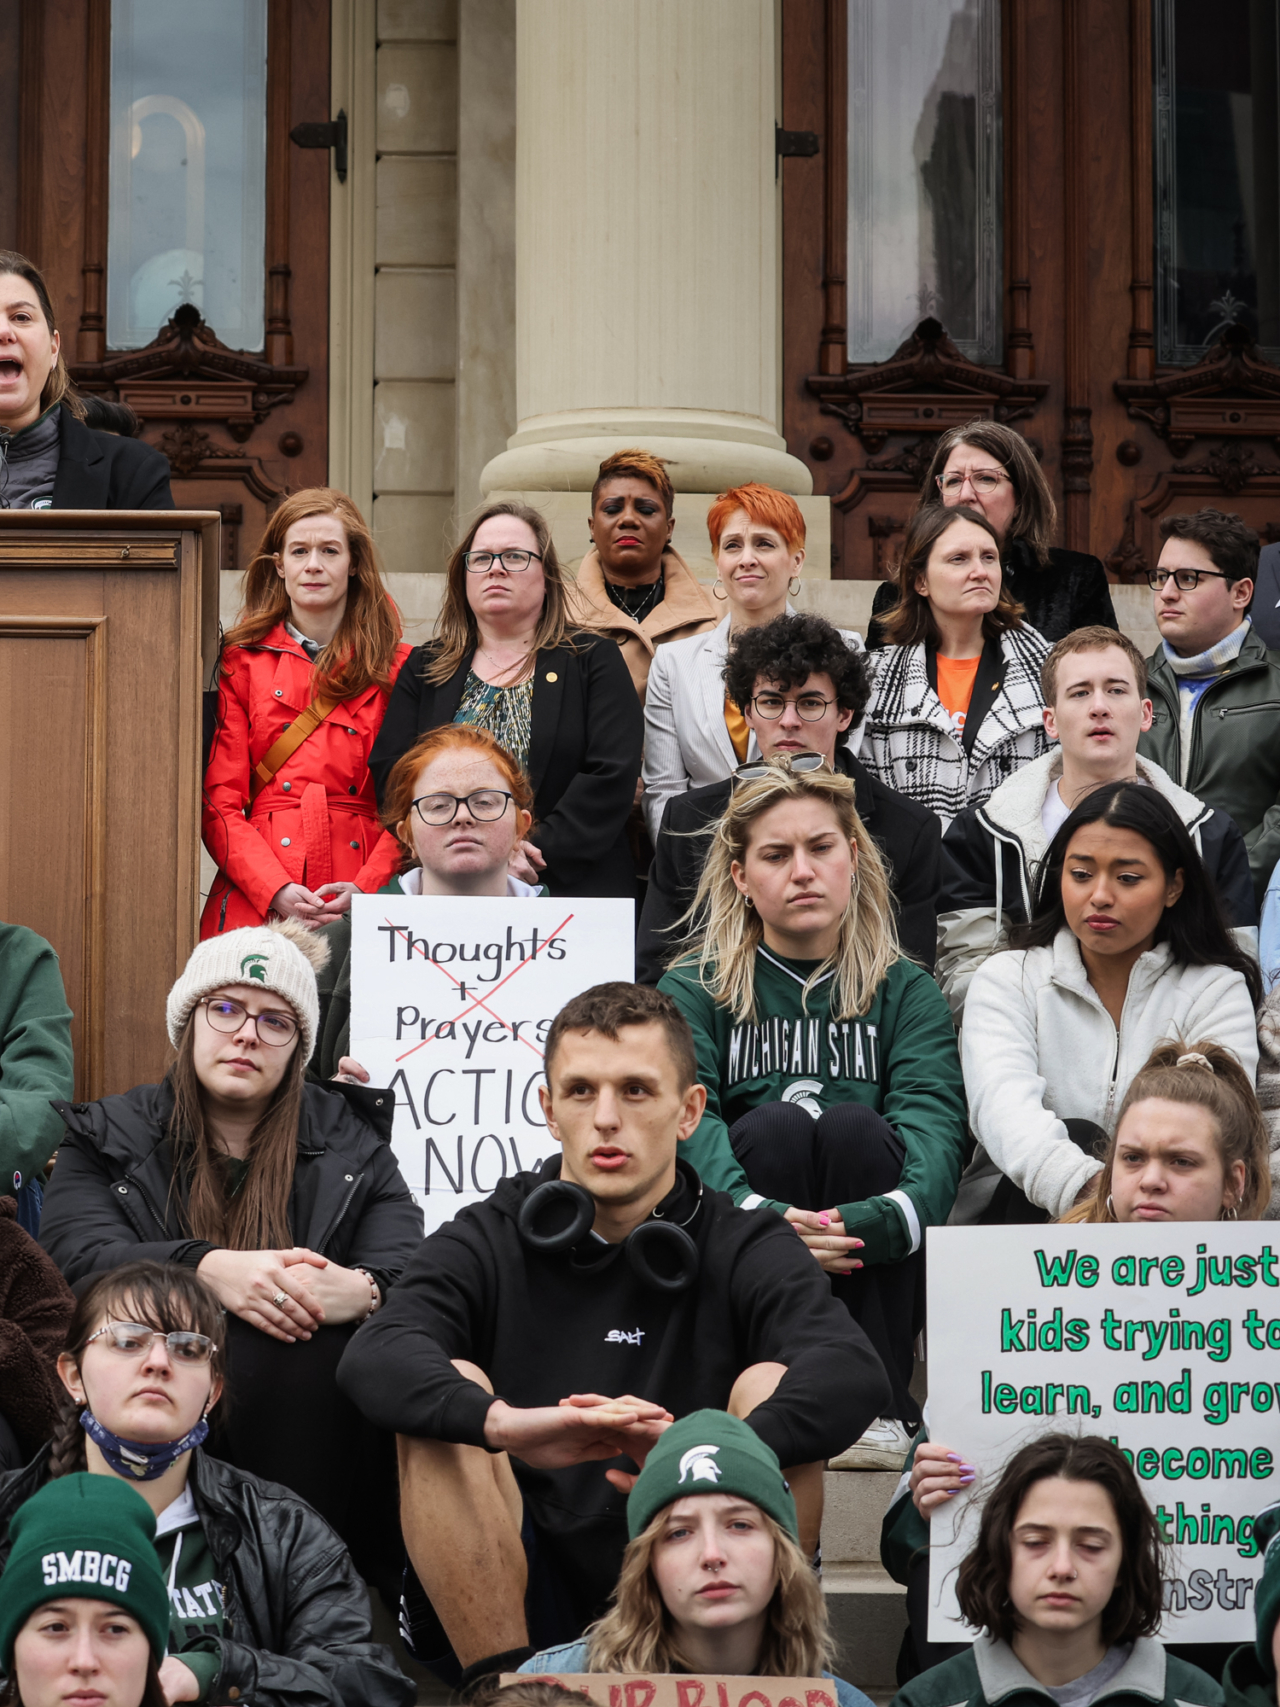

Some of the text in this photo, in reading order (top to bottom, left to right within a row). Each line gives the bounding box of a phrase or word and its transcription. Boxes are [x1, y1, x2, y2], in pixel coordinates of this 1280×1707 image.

[377, 926, 567, 982] Thoughts
[727, 1016, 820, 1086] MICHIGAN
[1034, 1243, 1280, 1296] We are just
[1000, 1307, 1090, 1352] kids
[1101, 1308, 1232, 1362] trying
[981, 1368, 1280, 1425] learn, and gro
[42, 1550, 132, 1592] SMBCG
[1161, 1568, 1260, 1612] nStr
